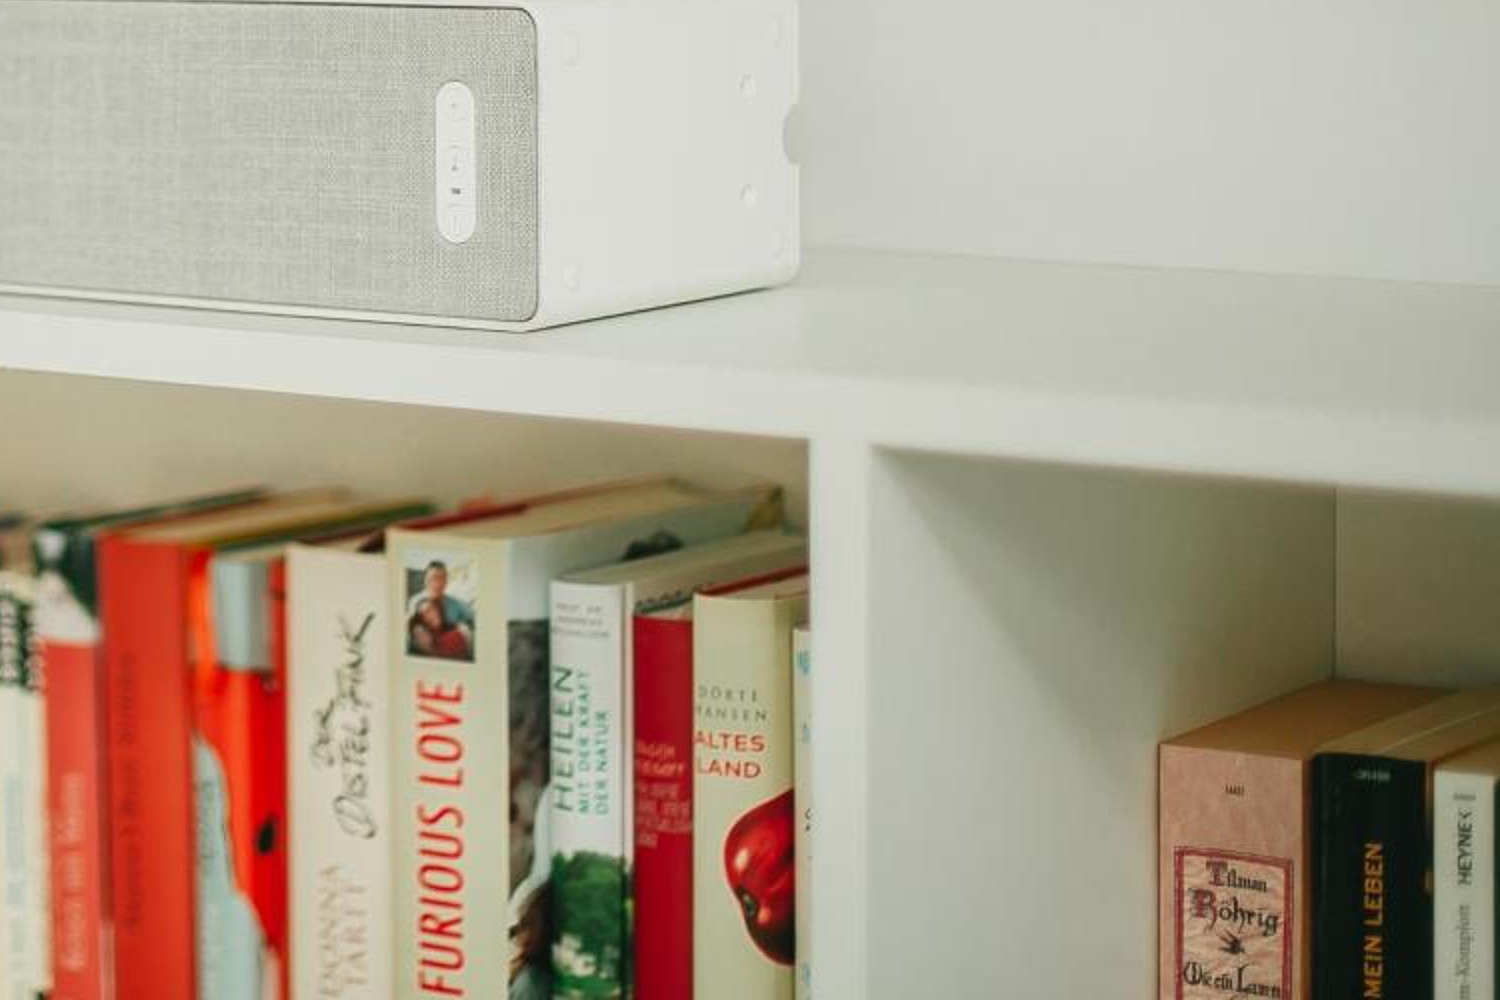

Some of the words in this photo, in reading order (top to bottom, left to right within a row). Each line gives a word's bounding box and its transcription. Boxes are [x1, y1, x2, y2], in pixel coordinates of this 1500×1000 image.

[577, 668, 591, 728] KRAFT
[417, 679, 464, 788] LOVE
[552, 665, 575, 812] HEILEN
[577, 735, 591, 773] DER
[595, 711, 610, 773] NATUR
[693, 729, 765, 752] ALTES
[577, 781, 591, 815] MIT
[595, 778, 610, 816] DER
[697, 758, 761, 779] LAND
[1205, 860, 1267, 893] Tilman
[1457, 820, 1473, 885] HEYNE
[417, 804, 464, 997] FURIOUS
[1187, 886, 1278, 937] Röhrig
[1364, 843, 1383, 927] LEBEN
[1364, 935, 1383, 999] MEIN
